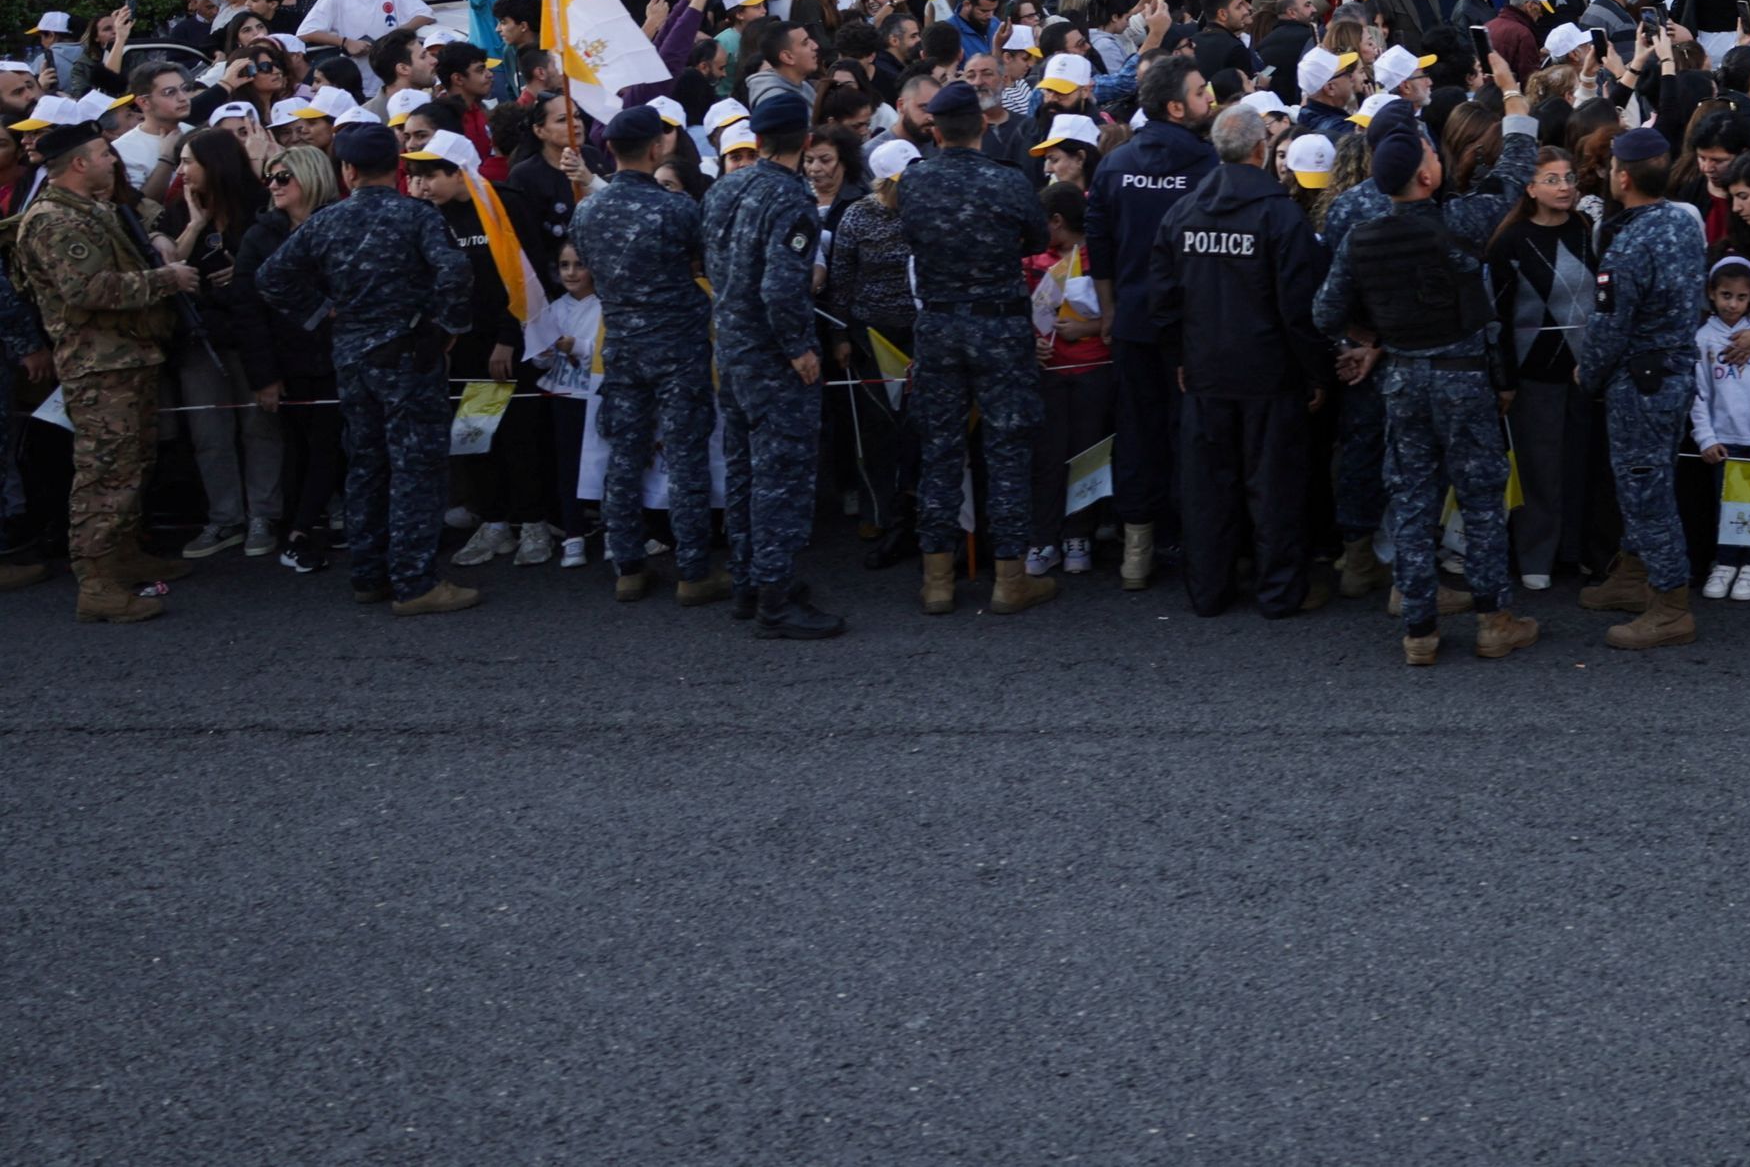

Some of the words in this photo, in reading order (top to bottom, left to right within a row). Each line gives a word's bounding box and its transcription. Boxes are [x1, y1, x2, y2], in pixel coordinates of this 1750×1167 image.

[1121, 173, 1187, 190] POLICE
[1182, 230, 1255, 257] POLICE
[1714, 366, 1742, 380] DAY
